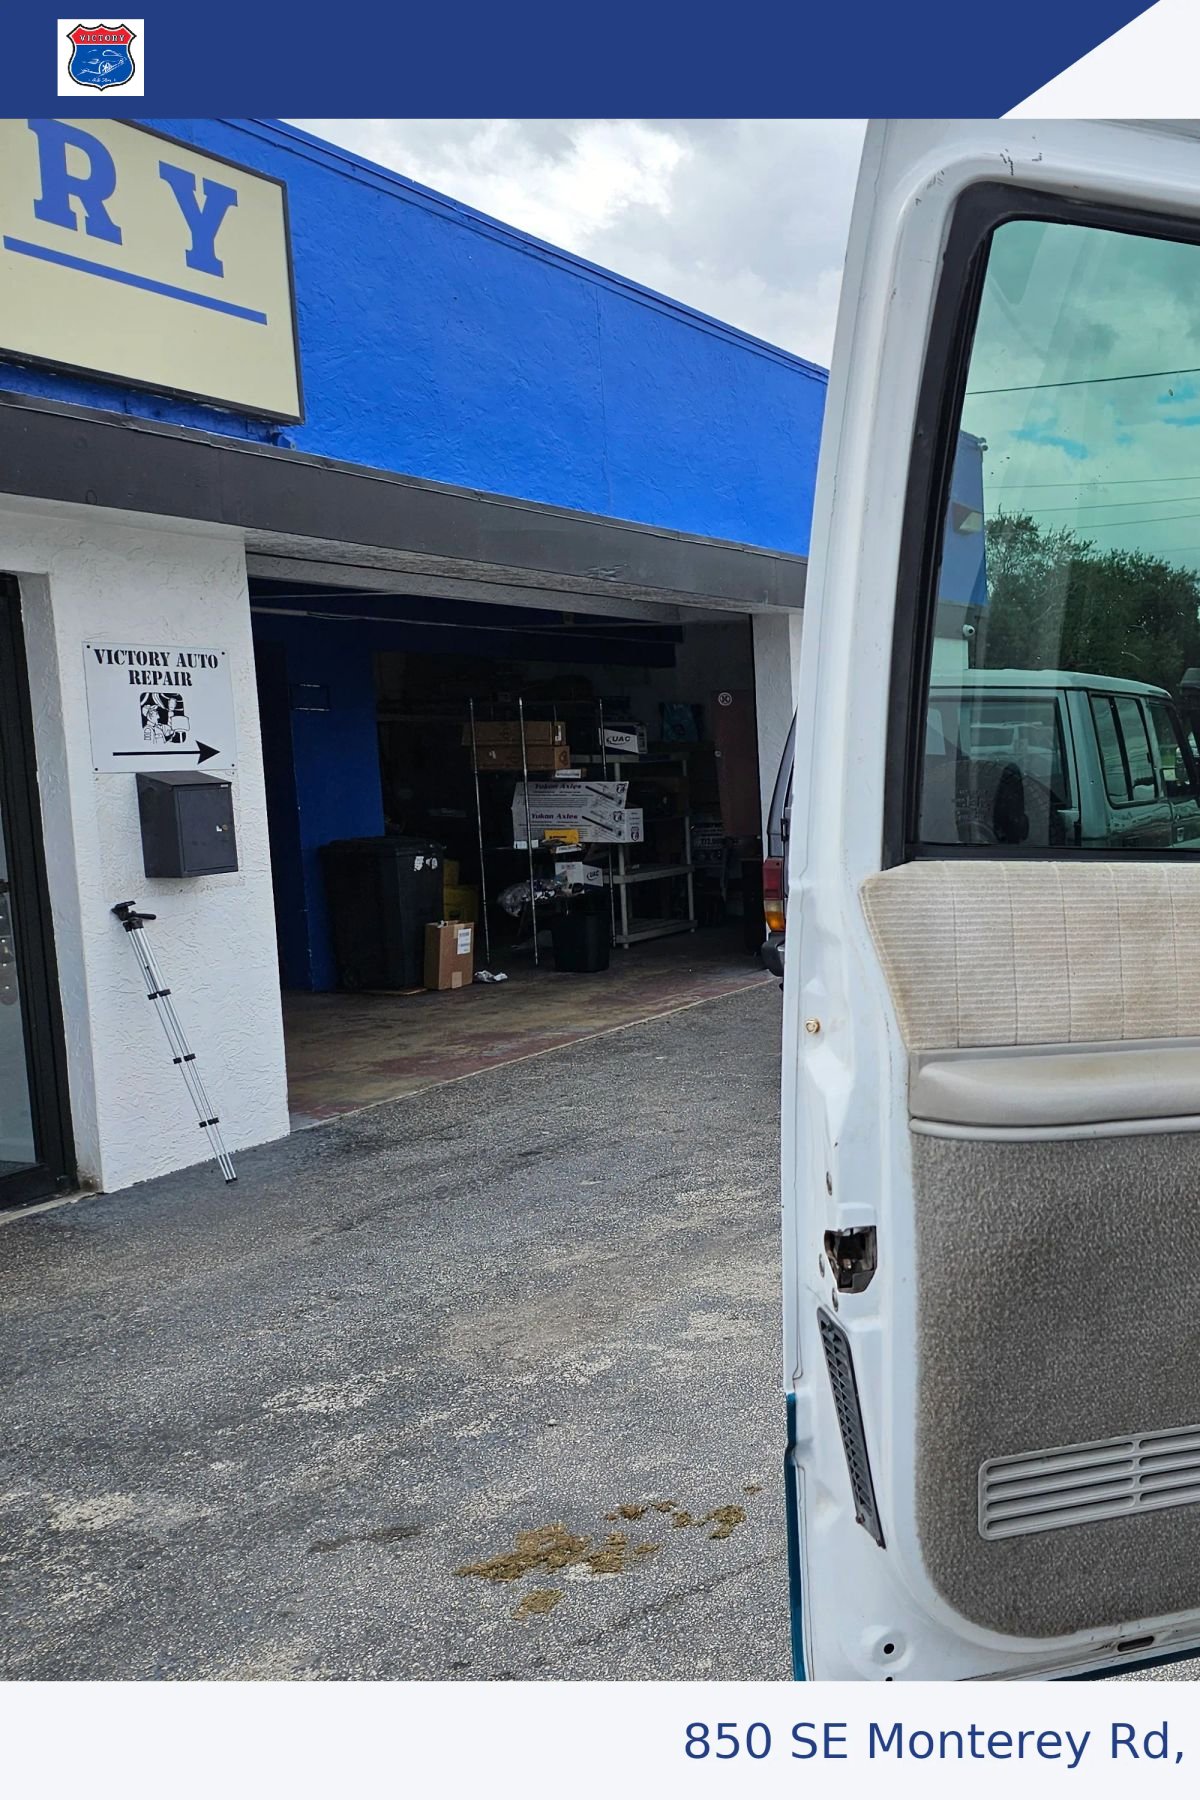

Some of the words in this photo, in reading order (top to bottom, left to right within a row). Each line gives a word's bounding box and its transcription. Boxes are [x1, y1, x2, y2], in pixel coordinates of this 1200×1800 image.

[93, 648, 170, 667] VICTORY
[176, 652, 219, 669] AUTO
[128, 669, 193, 687] REPAIR
[611, 735, 631, 743] UAC
